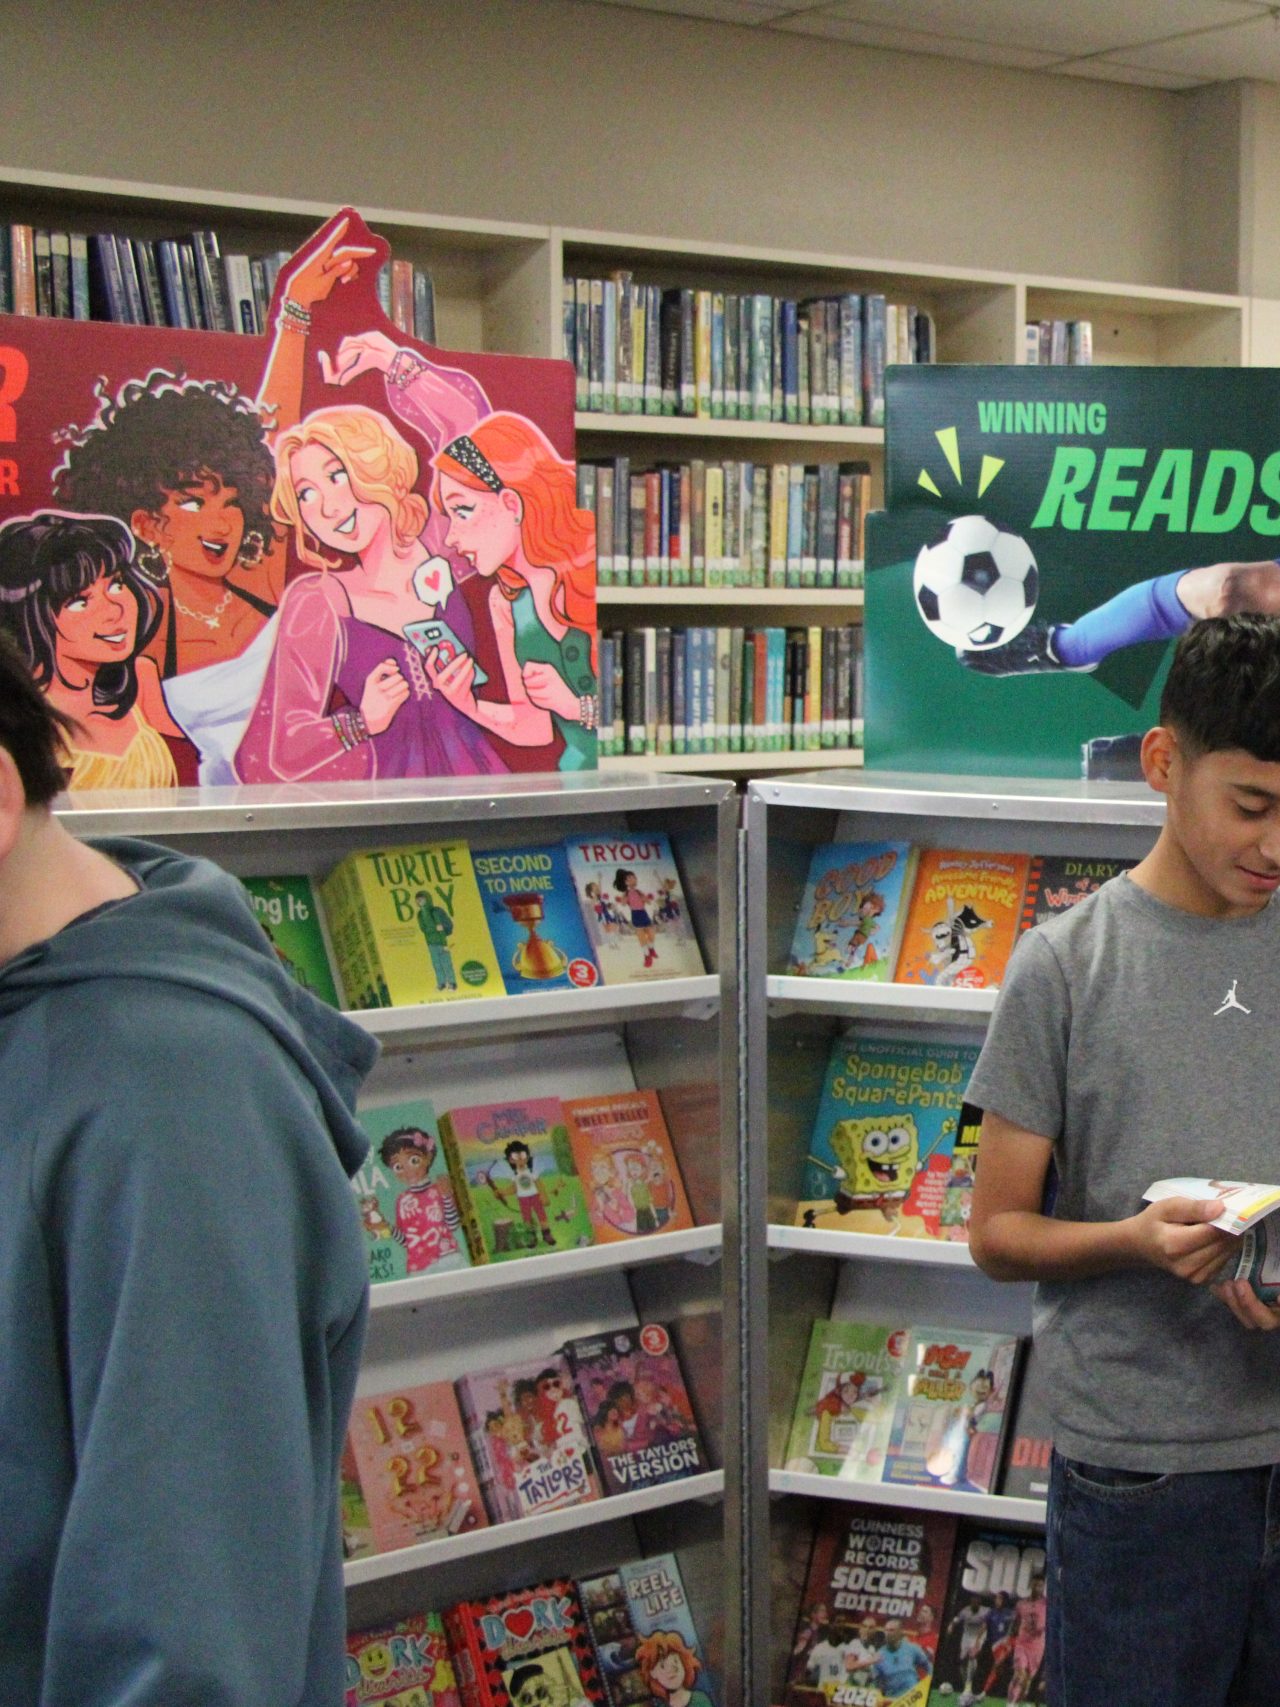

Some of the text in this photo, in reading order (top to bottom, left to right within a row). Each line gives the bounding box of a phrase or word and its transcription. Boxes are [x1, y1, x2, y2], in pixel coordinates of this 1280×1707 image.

[978, 401, 1107, 435] WINNING
[476, 853, 553, 876] SECOND
[578, 841, 663, 863] TRYOUT
[366, 846, 463, 889] TURTLE
[1064, 862, 1119, 878] DIARY
[483, 874, 555, 894] TO NONE
[924, 883, 1019, 910] ADVENTURE
[287, 893, 310, 921] It
[846, 1054, 963, 1089] SpongeBob
[574, 1112, 609, 1128] SWEET
[607, 1437, 698, 1469] THE TAYLORS
[518, 1458, 584, 1505] TAYLORS
[612, 1451, 701, 1485] VERSION
[850, 1517, 924, 1538] GUINNESS
[848, 1533, 922, 1556] WORLD
[843, 1549, 920, 1571] RECORDS
[961, 1539, 1048, 1598] SOC
[628, 1570, 675, 1600] REEL
[830, 1565, 928, 1599] SOCCER
[645, 1587, 684, 1618] LIFE
[833, 1591, 915, 1618] EDITION
